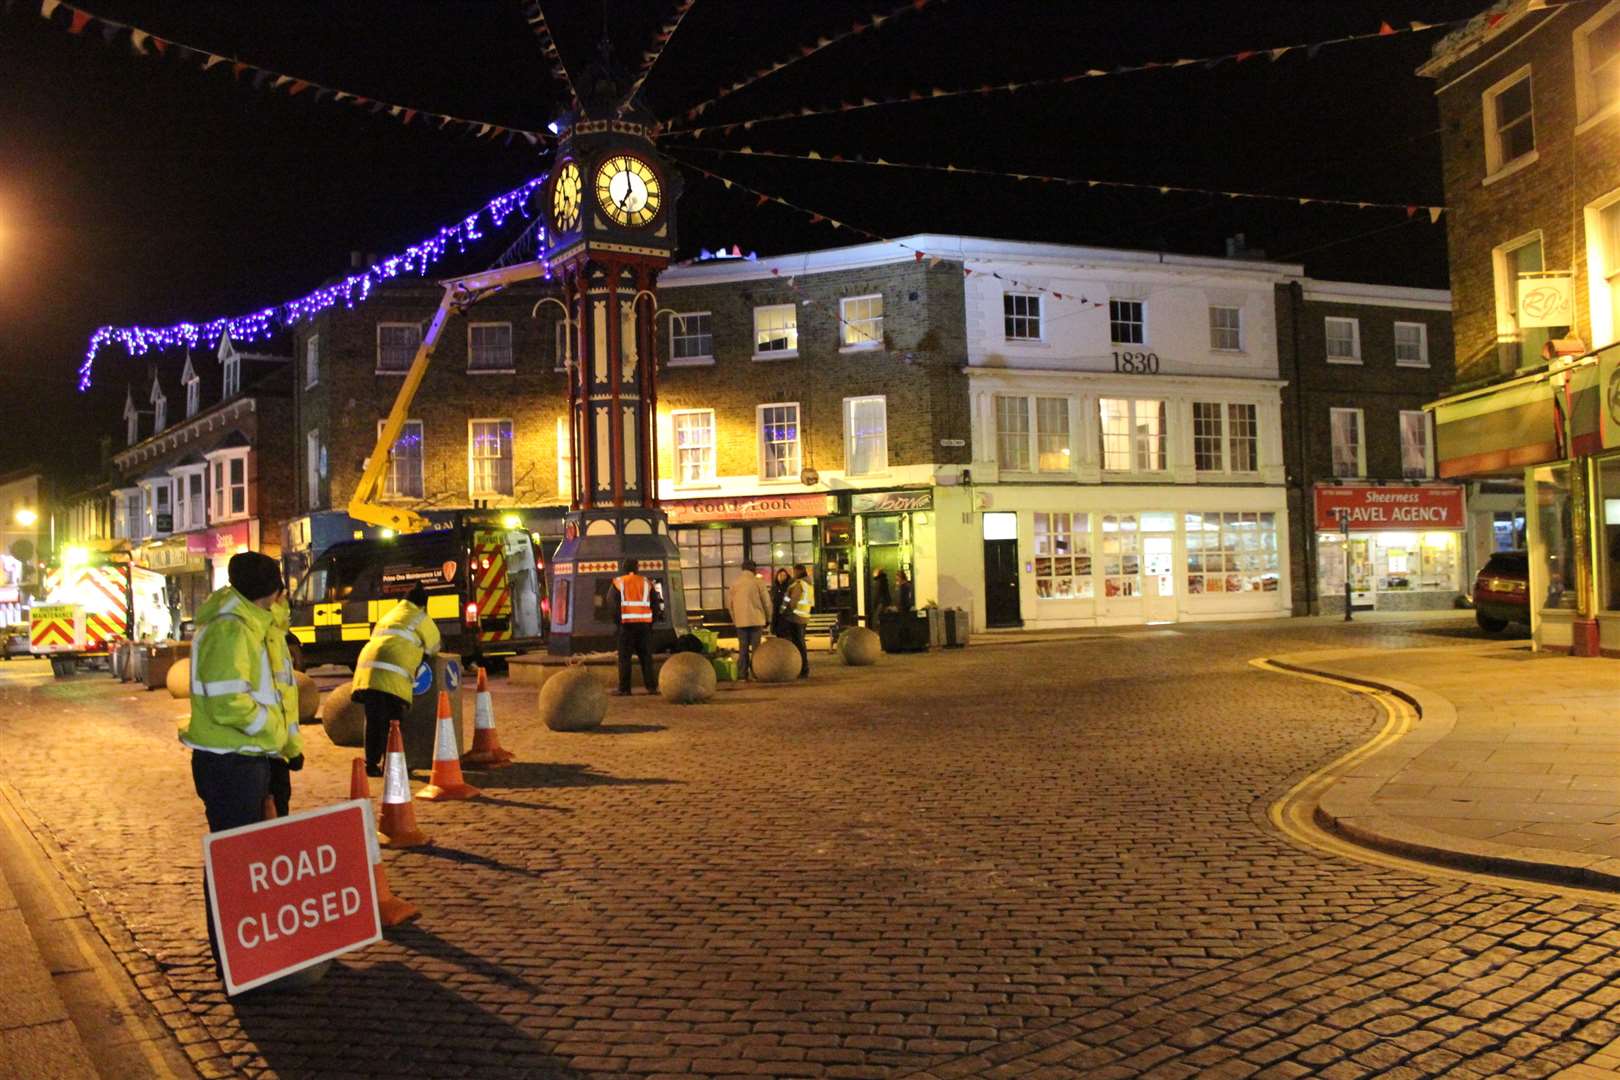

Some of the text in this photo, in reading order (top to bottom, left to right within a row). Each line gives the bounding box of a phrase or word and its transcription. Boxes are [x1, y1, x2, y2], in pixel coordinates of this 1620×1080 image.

[1111, 351, 1160, 374] 1830
[1365, 491, 1420, 504] Sheerness
[1331, 506, 1448, 521] TRAVEL AGENCY
[249, 844, 337, 893] ROAD
[237, 886, 361, 949] CLOSED
